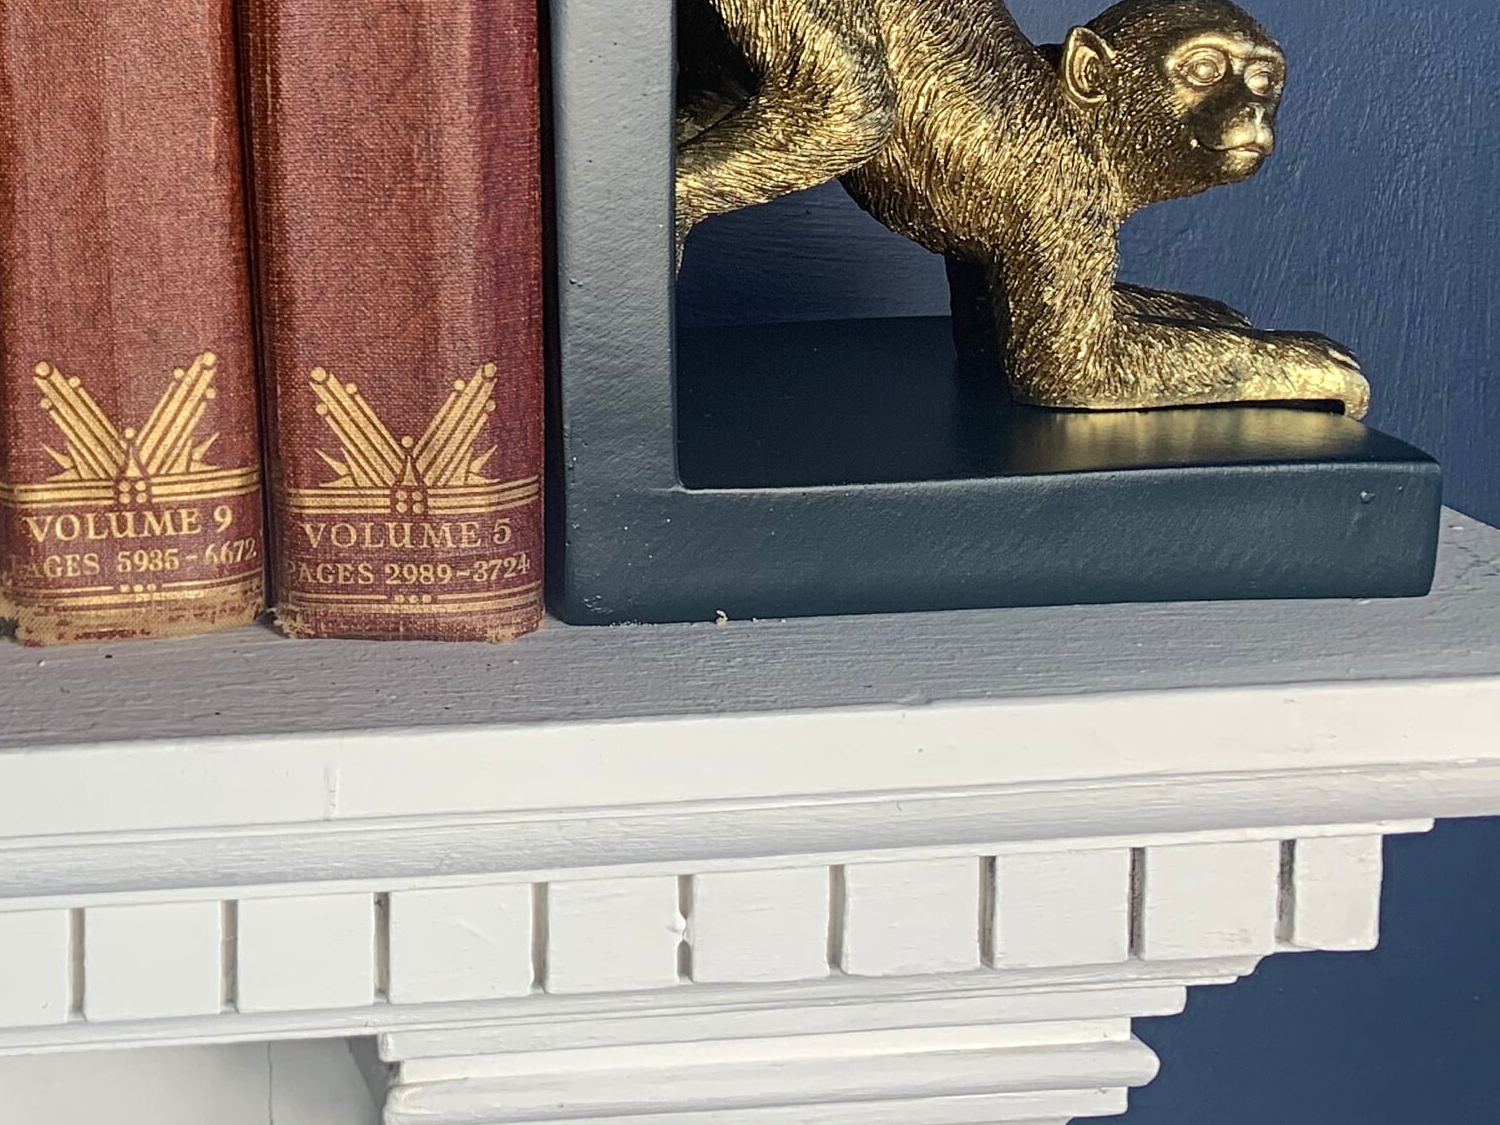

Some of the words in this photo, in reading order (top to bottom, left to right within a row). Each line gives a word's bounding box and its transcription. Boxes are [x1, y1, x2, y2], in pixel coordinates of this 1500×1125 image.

[23, 507, 202, 543] VOLUME
[213, 505, 233, 534] 9
[300, 519, 482, 549] VOLUME
[493, 518, 512, 545] 5
